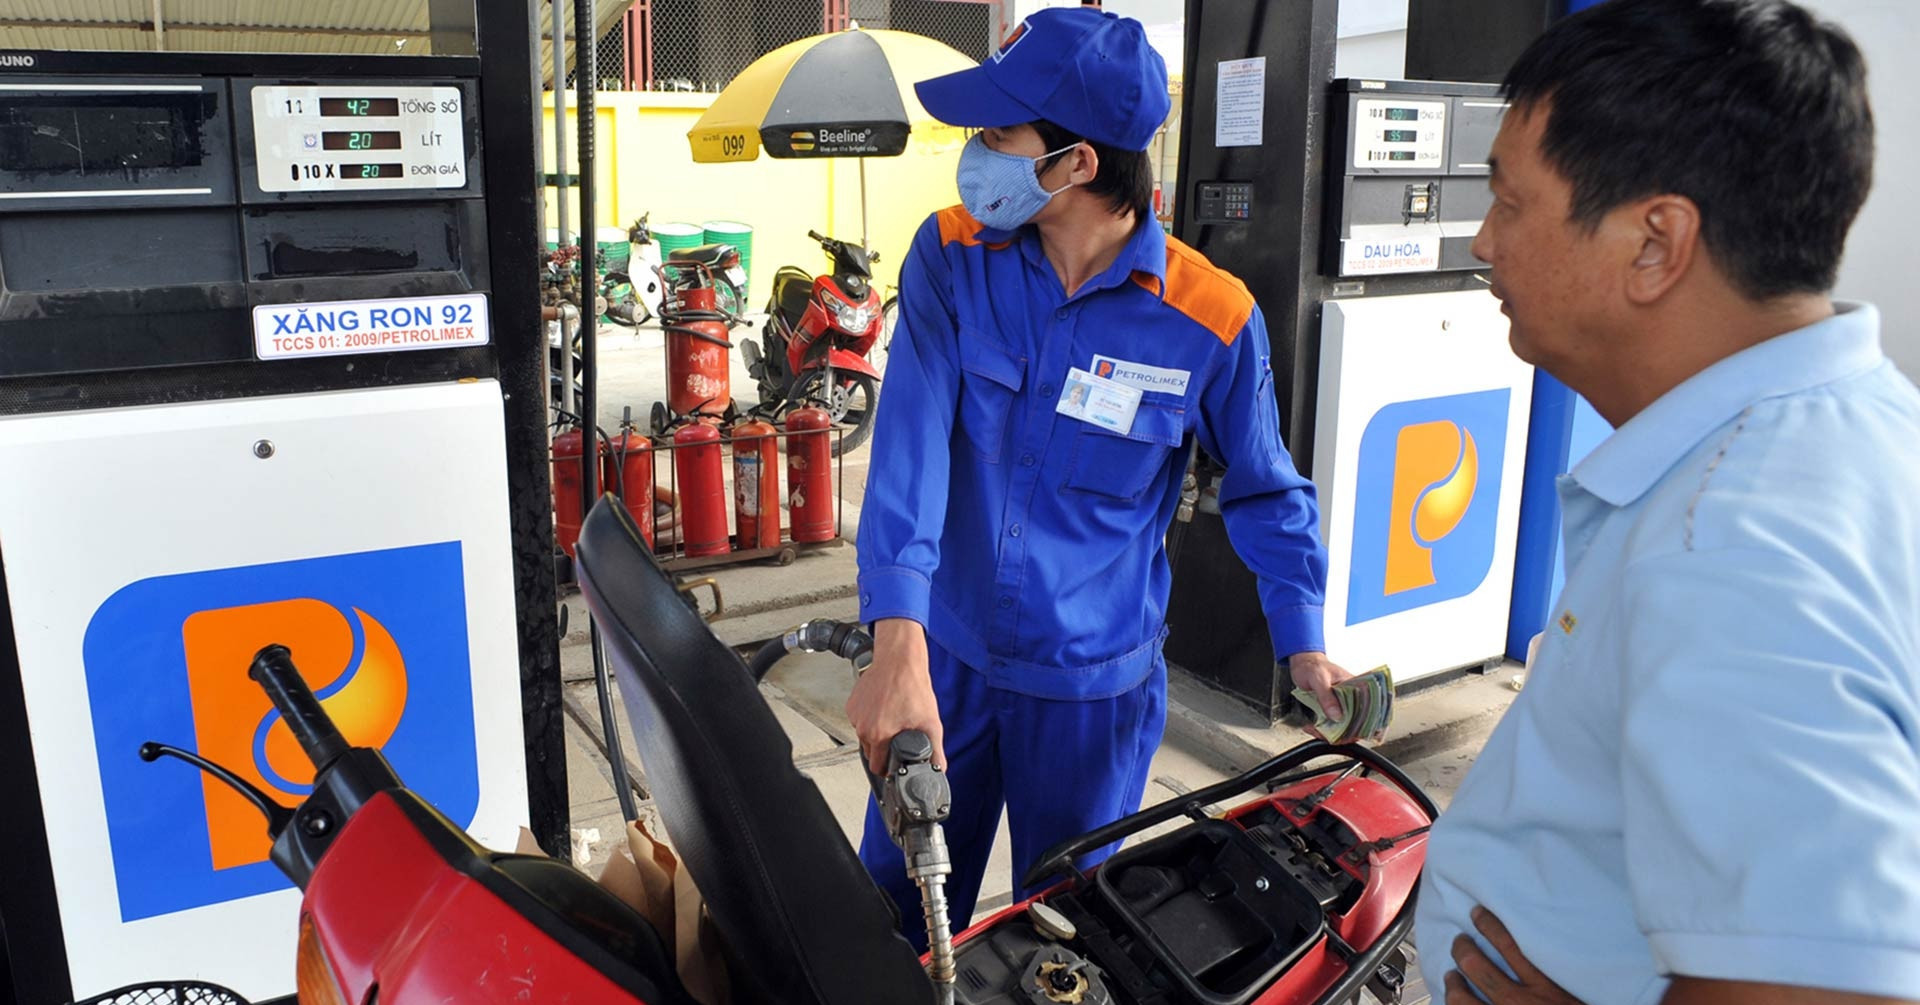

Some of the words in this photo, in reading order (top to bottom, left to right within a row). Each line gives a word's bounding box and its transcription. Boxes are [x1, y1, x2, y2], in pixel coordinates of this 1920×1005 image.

[0, 55, 34, 67] UNO
[347, 99, 370, 116] 42
[441, 98, 458, 113] SỐ
[421, 130, 442, 146] LÍT
[723, 134, 745, 156] 099
[303, 164, 321, 179] 10
[325, 163, 335, 178] X
[361, 165, 380, 178] 20
[438, 161, 460, 175] GIÁ
[272, 308, 360, 335] XĂNG
[369, 306, 432, 329] RON
[441, 304, 473, 324] 92
[272, 336, 315, 352] TCCS
[318, 335, 340, 349] 01:
[344, 326, 475, 347] 2009/PETROLIMEX
[1115, 368, 1186, 388] PETROLIMEX
